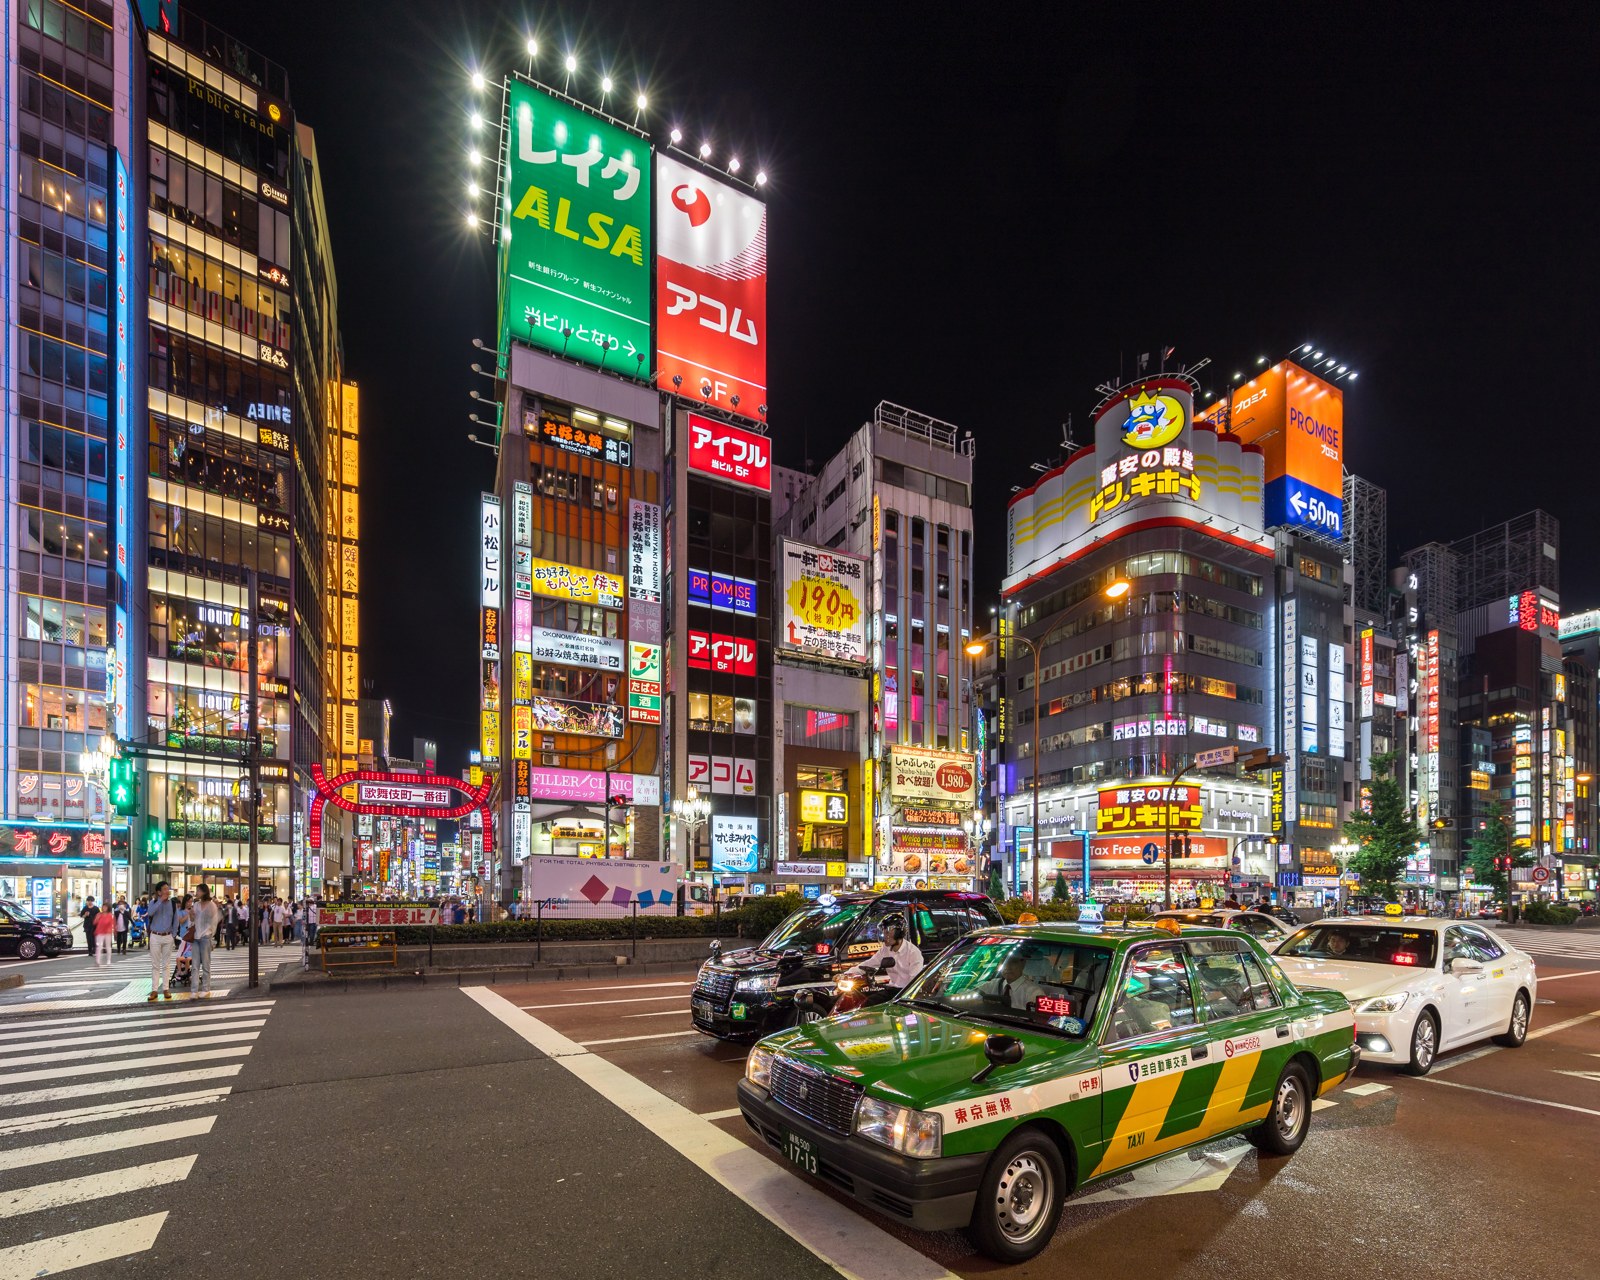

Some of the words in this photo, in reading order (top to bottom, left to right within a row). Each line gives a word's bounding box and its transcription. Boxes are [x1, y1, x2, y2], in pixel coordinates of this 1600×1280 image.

[188, 79, 230, 113] Public
[235, 109, 274, 138] stand
[518, 101, 641, 200] レイク
[513, 184, 643, 266] ALSA
[528, 261, 580, 286] 新生銀行グループ
[583, 280, 632, 305] 新生フィナンシャル
[666, 280, 758, 346] アコム
[524, 305, 619, 351] 当ビルとなり
[1235, 388, 1268, 414] プロミス
[544, 421, 603, 451] お好み焼
[1290, 406, 1339, 449] PROMISE
[272, 440, 289, 451] BAR
[692, 425, 767, 468] アイフル
[1320, 443, 1339, 461] プロミス
[711, 459, 733, 473] 当ビル
[735, 465, 750, 478] 5F
[1101, 447, 1194, 487] 驚安の殿堂
[1309, 497, 1340, 531] 50m
[484, 513, 499, 592] 小松ビル
[534, 566, 570, 579] お好み
[788, 550, 860, 579] 一軒め酒場
[547, 575, 588, 589] もんじゃ
[569, 586, 592, 597] たこ
[593, 573, 619, 592] 焼き
[692, 575, 751, 600] PROMISE
[727, 597, 750, 608] プロミス
[199, 606, 249, 629] DOUTOR
[485, 609, 498, 643] お好み焼
[542, 630, 586, 643] OKONOMIYAKI
[588, 638, 611, 647] HONJIN
[804, 635, 857, 653] 左の路地を右へ
[536, 646, 598, 664] お好み焼き本陣
[691, 635, 753, 663] アイフル
[717, 661, 728, 670] 5F
[260, 682, 288, 695] DOUTOR
[631, 681, 660, 694] たばこ
[638, 696, 651, 707] 酒
[631, 710, 660, 722] 銀行ATM
[895, 756, 936, 768] しゃぶしゃぶ
[1199, 750, 1231, 762] 歌舞伎町
[260, 766, 288, 777] DOUTOR
[517, 760, 529, 796] お好み焼
[689, 760, 753, 784] アコム
[941, 774, 964, 788] 1,980
[19, 775, 83, 796] ダーツ
[533, 773, 580, 788] FILLER
[590, 777, 632, 791] CLNIC
[19, 796, 47, 806] CAFE
[364, 787, 447, 803] 歌舞伎町一番街
[532, 787, 559, 796] フィラー
[560, 789, 595, 798] クリニック
[827, 797, 845, 819] 集
[1232, 810, 1252, 819] Quijote
[1048, 814, 1075, 825] Quijote
[1091, 846, 1108, 856] Tax
[1113, 844, 1142, 855] Free
[36, 882, 44, 893] P
[1038, 997, 1070, 1016] 空車
[1245, 1037, 1260, 1049] 5662
[1141, 1055, 1188, 1077] 宝自動車交通
[1079, 1075, 1102, 1094] (中野)
[954, 1097, 1013, 1125] 東京無線
[800, 1139, 810, 1152] 500
[1127, 1131, 1146, 1150] TAXI
[790, 1143, 817, 1174] 17-13
